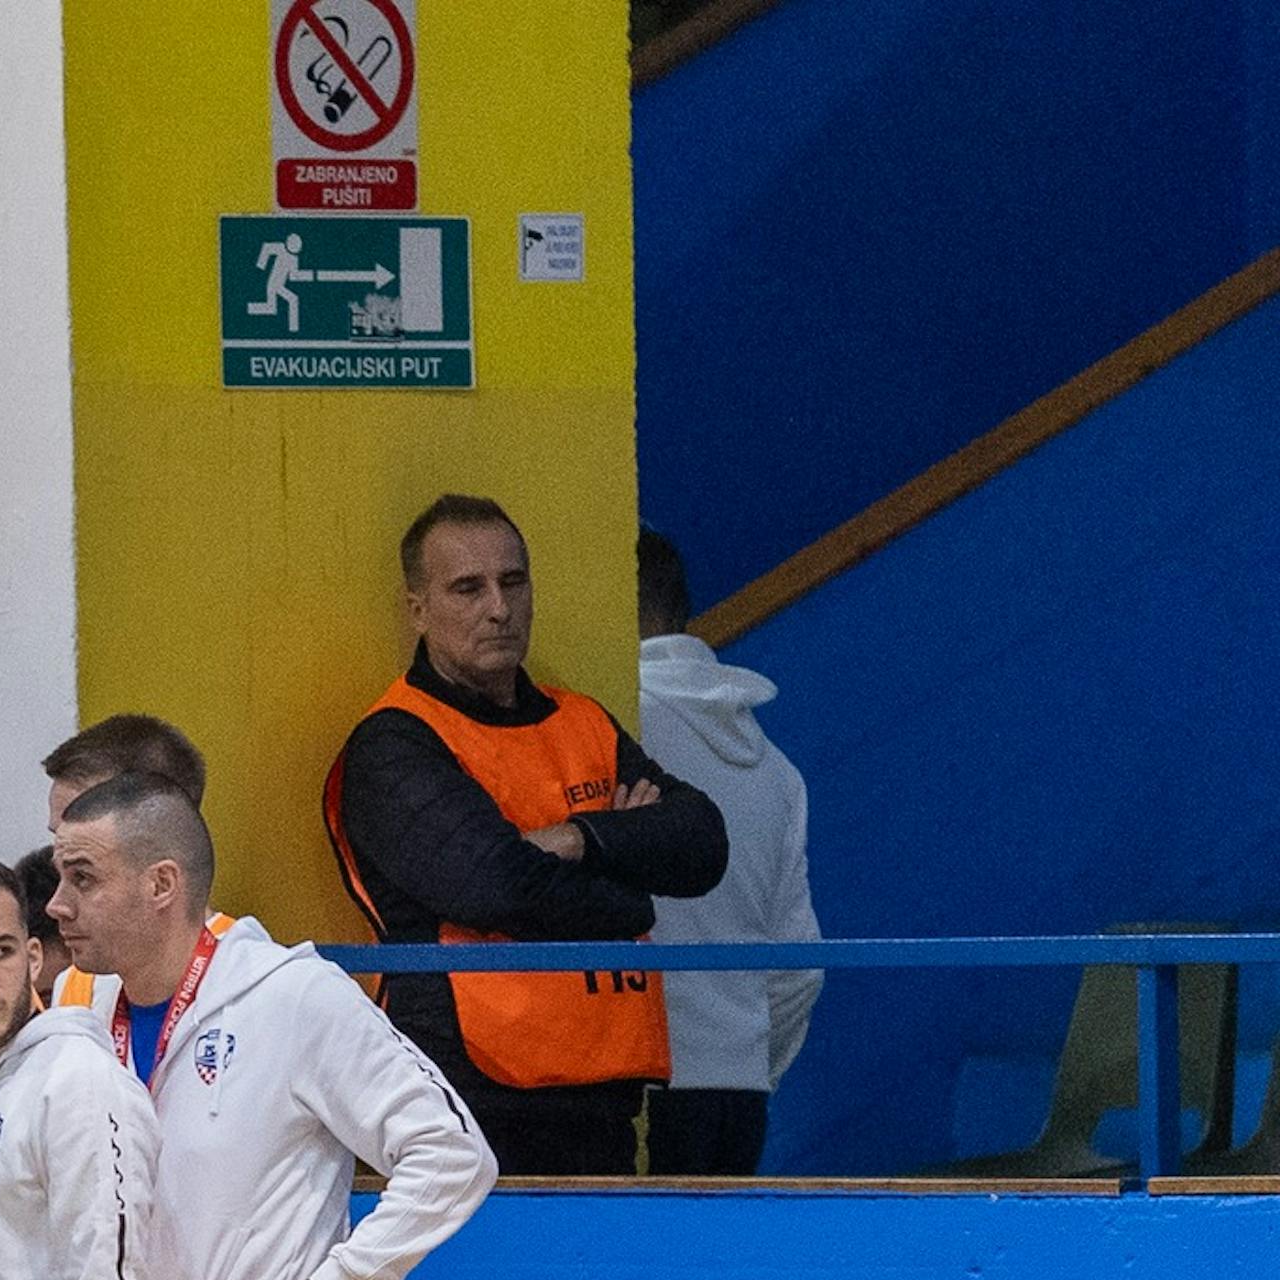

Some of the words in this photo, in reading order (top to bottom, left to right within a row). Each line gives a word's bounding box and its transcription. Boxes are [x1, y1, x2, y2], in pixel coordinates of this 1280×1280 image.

[295, 165, 398, 184] ZABRANJENO
[321, 184, 373, 206] PUŠITI
[250, 356, 396, 379] EVAKUACIJSKI
[400, 356, 443, 380] PUT
